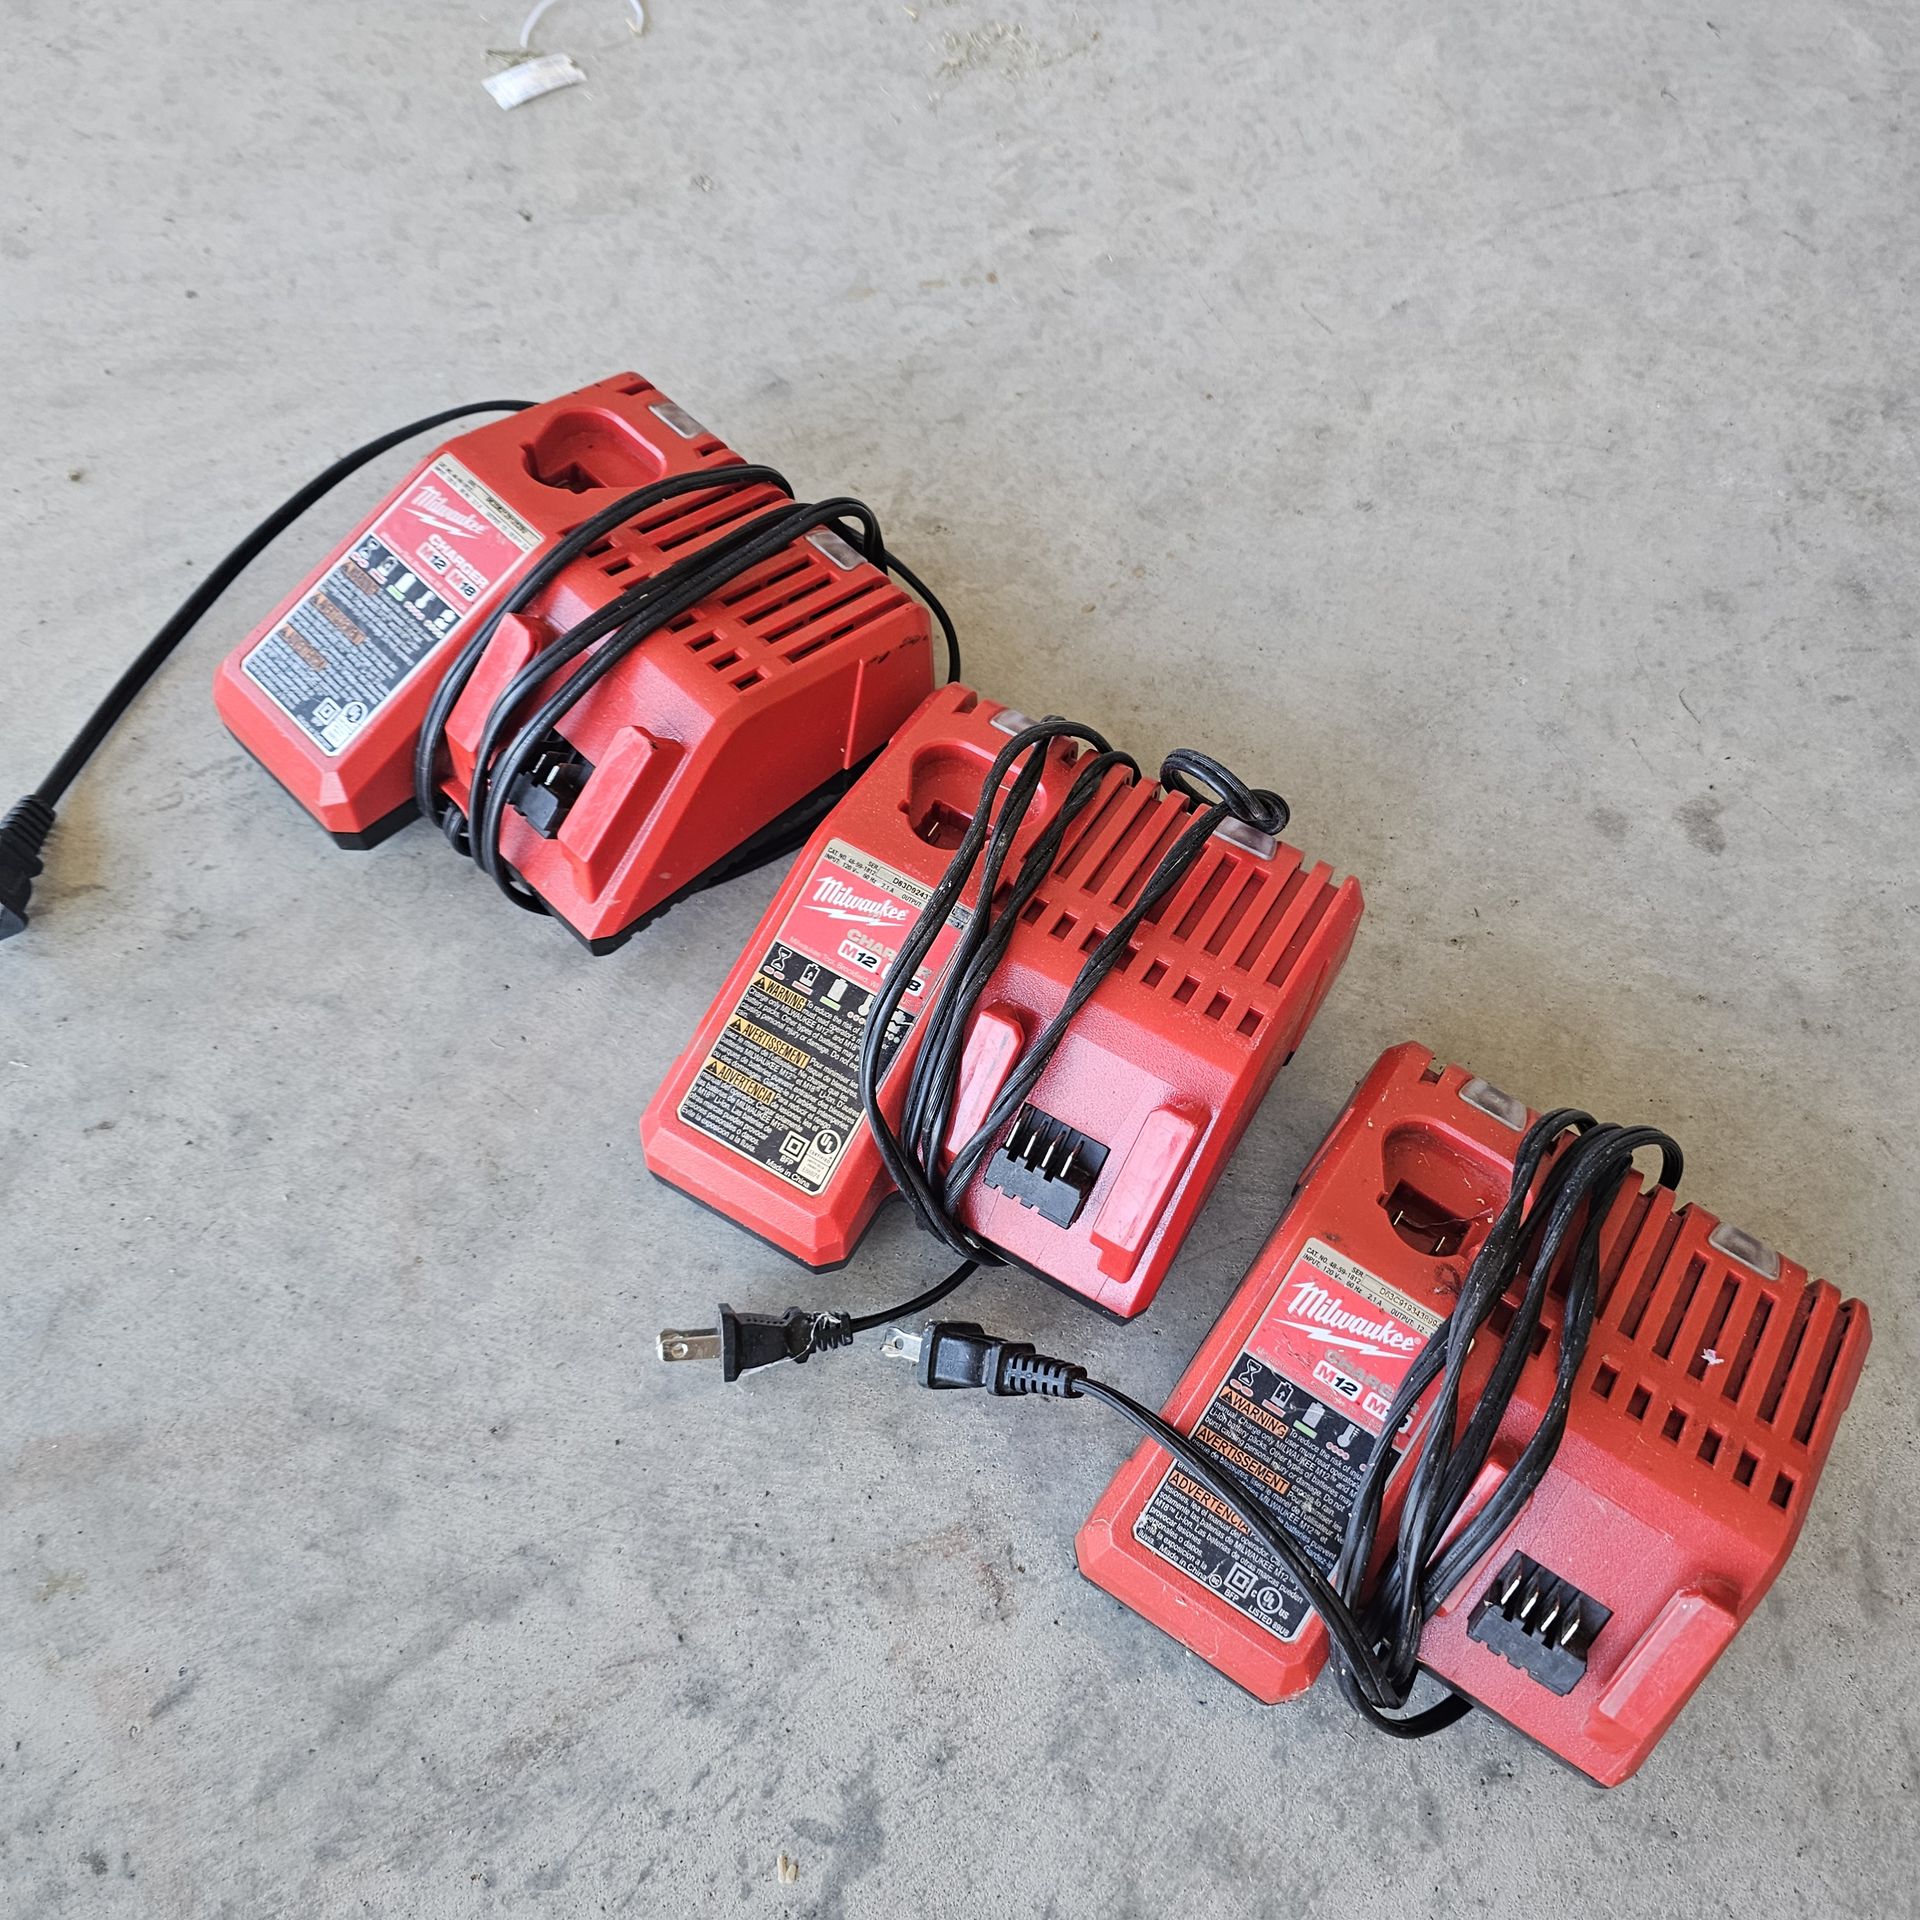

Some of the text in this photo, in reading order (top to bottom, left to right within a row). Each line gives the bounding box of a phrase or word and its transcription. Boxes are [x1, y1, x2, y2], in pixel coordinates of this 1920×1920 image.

[419, 545, 477, 598] M12 M18
[425, 532, 492, 589] CHARGER
[841, 942, 878, 969] M12
[747, 985, 769, 1003] Charge
[766, 997, 782, 1011] only
[779, 1003, 817, 1028] MILWAUKEE
[832, 1033, 844, 1043] and
[764, 980, 860, 1034] WARNING To reduce the risk of
[801, 1006, 817, 1019] must
[815, 1014, 830, 1026] read
[827, 1021, 857, 1043] operator's
[741, 1022, 860, 1089] AVERTISSEMENT Pour minimiser les
[760, 1011, 785, 1030] personal
[783, 1024, 801, 1039] injury
[805, 1037, 831, 1056] damage.
[830, 1050, 840, 1060] Do
[839, 1055, 850, 1065] not
[780, 1013, 797, 1027] Other
[795, 1022, 813, 1037] types
[811, 1030, 821, 1039] of
[817, 1034, 843, 1052] batteries
[840, 1047, 855, 1061] may
[720, 1053, 732, 1064] des
[743, 1047, 803, 1085] MILWAUKEE et
[717, 1064, 831, 1130] ADVERTENCIA Para reducir riesgo
[797, 1069, 808, 1079] Ne
[838, 1092, 849, 1102] les
[804, 1063, 860, 1099] risque de blessures,
[730, 1105, 743, 1116] Las
[770, 1100, 779, 1109] de
[816, 1098, 856, 1125] des blessures
[742, 1122, 768, 1142] provocar
[765, 1157, 785, 1173] Made
[783, 1168, 792, 1177] in
[790, 1172, 811, 1188] China
[779, 1154, 794, 1167] BFP
[1322, 1265, 1335, 1276] 120
[1316, 1364, 1359, 1397] M12
[1212, 1400, 1350, 1493] manual. Charge only MILWAUKEE and
[1230, 1394, 1350, 1472] WARNING To reduce the risk of
[1195, 1426, 1289, 1492] AVERTISSEMENT
[1290, 1484, 1316, 1503] expose
[1320, 1503, 1337, 1517] rain.
[1203, 1416, 1221, 1430] burst
[1218, 1426, 1245, 1447] causing
[1243, 1442, 1272, 1464] personal
[1269, 1459, 1289, 1476] injury
[1287, 1471, 1297, 1480] or
[1294, 1475, 1324, 1499] damage.
[1322, 1493, 1334, 1504] Do
[1333, 1500, 1346, 1512] not
[1225, 1418, 1249, 1438] battery
[1247, 1433, 1270, 1452] packs.
[1268, 1446, 1289, 1464] Other
[1284, 1459, 1305, 1476] types
[1303, 1469, 1313, 1479] of
[1310, 1474, 1340, 1497] batteries
[1337, 1493, 1353, 1508] may
[1283, 1436, 1299, 1450] user
[1297, 1446, 1315, 1460] must
[1314, 1456, 1330, 1470] read
[1168, 1471, 1253, 1532] ADVERTENCIA
[1209, 1450, 1220, 1460] de
[1217, 1456, 1251, 1482] blessures,
[1249, 1476, 1266, 1491] lisez
[1290, 1504, 1301, 1515] de
[1148, 1505, 1203, 1545] provocar lesiones
[1157, 1490, 1192, 1516] solamente
[1189, 1510, 1201, 1523] las
[1223, 1534, 1234, 1545] de
[1232, 1540, 1276, 1572] MILWAUKEE
[1162, 1482, 1191, 1505] lesiones,
[1189, 1500, 1201, 1512] lea
[1200, 1507, 1208, 1516] el
[1206, 1511, 1231, 1532] manual
[1229, 1527, 1241, 1538] del
[1239, 1535, 1271, 1560] operador.
[1257, 1493, 1300, 1525] MILWAUKEE
[1319, 1534, 1328, 1544] et
[1282, 1521, 1311, 1543] batteries
[1331, 1520, 1343, 1532] les
[1158, 1543, 1180, 1561] Made
[1178, 1557, 1188, 1567] in
[1186, 1562, 1209, 1581] China
[1193, 1524, 1208, 1537] Las
[1230, 1550, 1241, 1560] de
[1239, 1556, 1257, 1571] otras
[1255, 1567, 1280, 1587] marcas
[1278, 1583, 1304, 1604] pueden
[1199, 1560, 1208, 1570] la
[1223, 1588, 1239, 1602] BFP
[1277, 1608, 1289, 1620] US
[1247, 1604, 1273, 1625] LISTED
